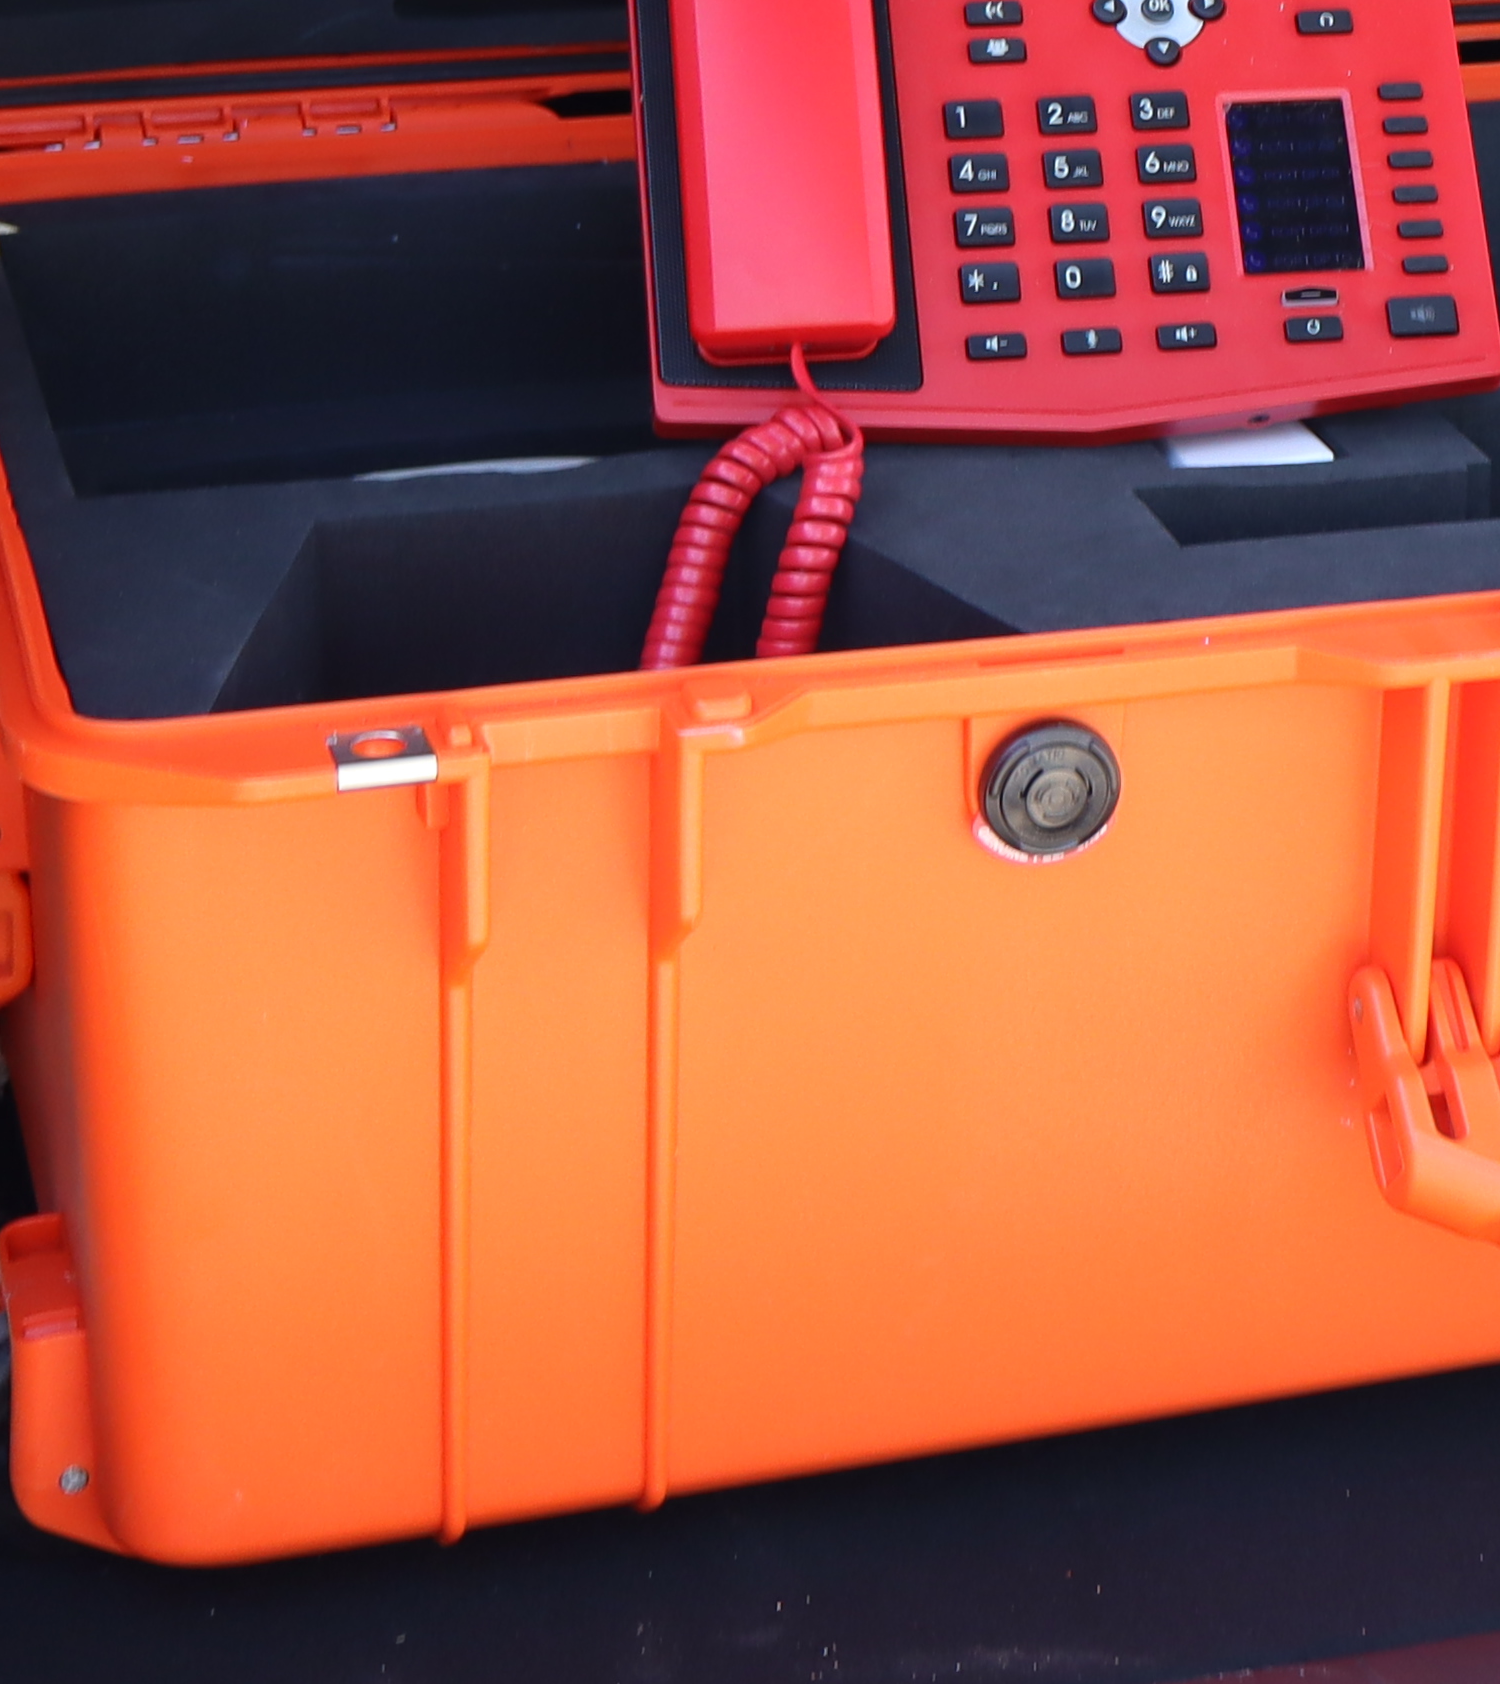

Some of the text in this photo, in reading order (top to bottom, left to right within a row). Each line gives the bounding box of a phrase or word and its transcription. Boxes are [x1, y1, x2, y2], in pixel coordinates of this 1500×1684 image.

[955, 106, 967, 128] 1
[1047, 103, 1064, 125] 2
[1139, 98, 1176, 121] 3 DEF
[959, 159, 997, 182] 4 GHI
[1054, 156, 1070, 179] 5
[1145, 151, 1161, 174] 6
[963, 213, 979, 236] 7
[1060, 209, 1098, 232] 8 TUV
[1151, 205, 1167, 229] 9
[1065, 266, 1082, 289] 0
